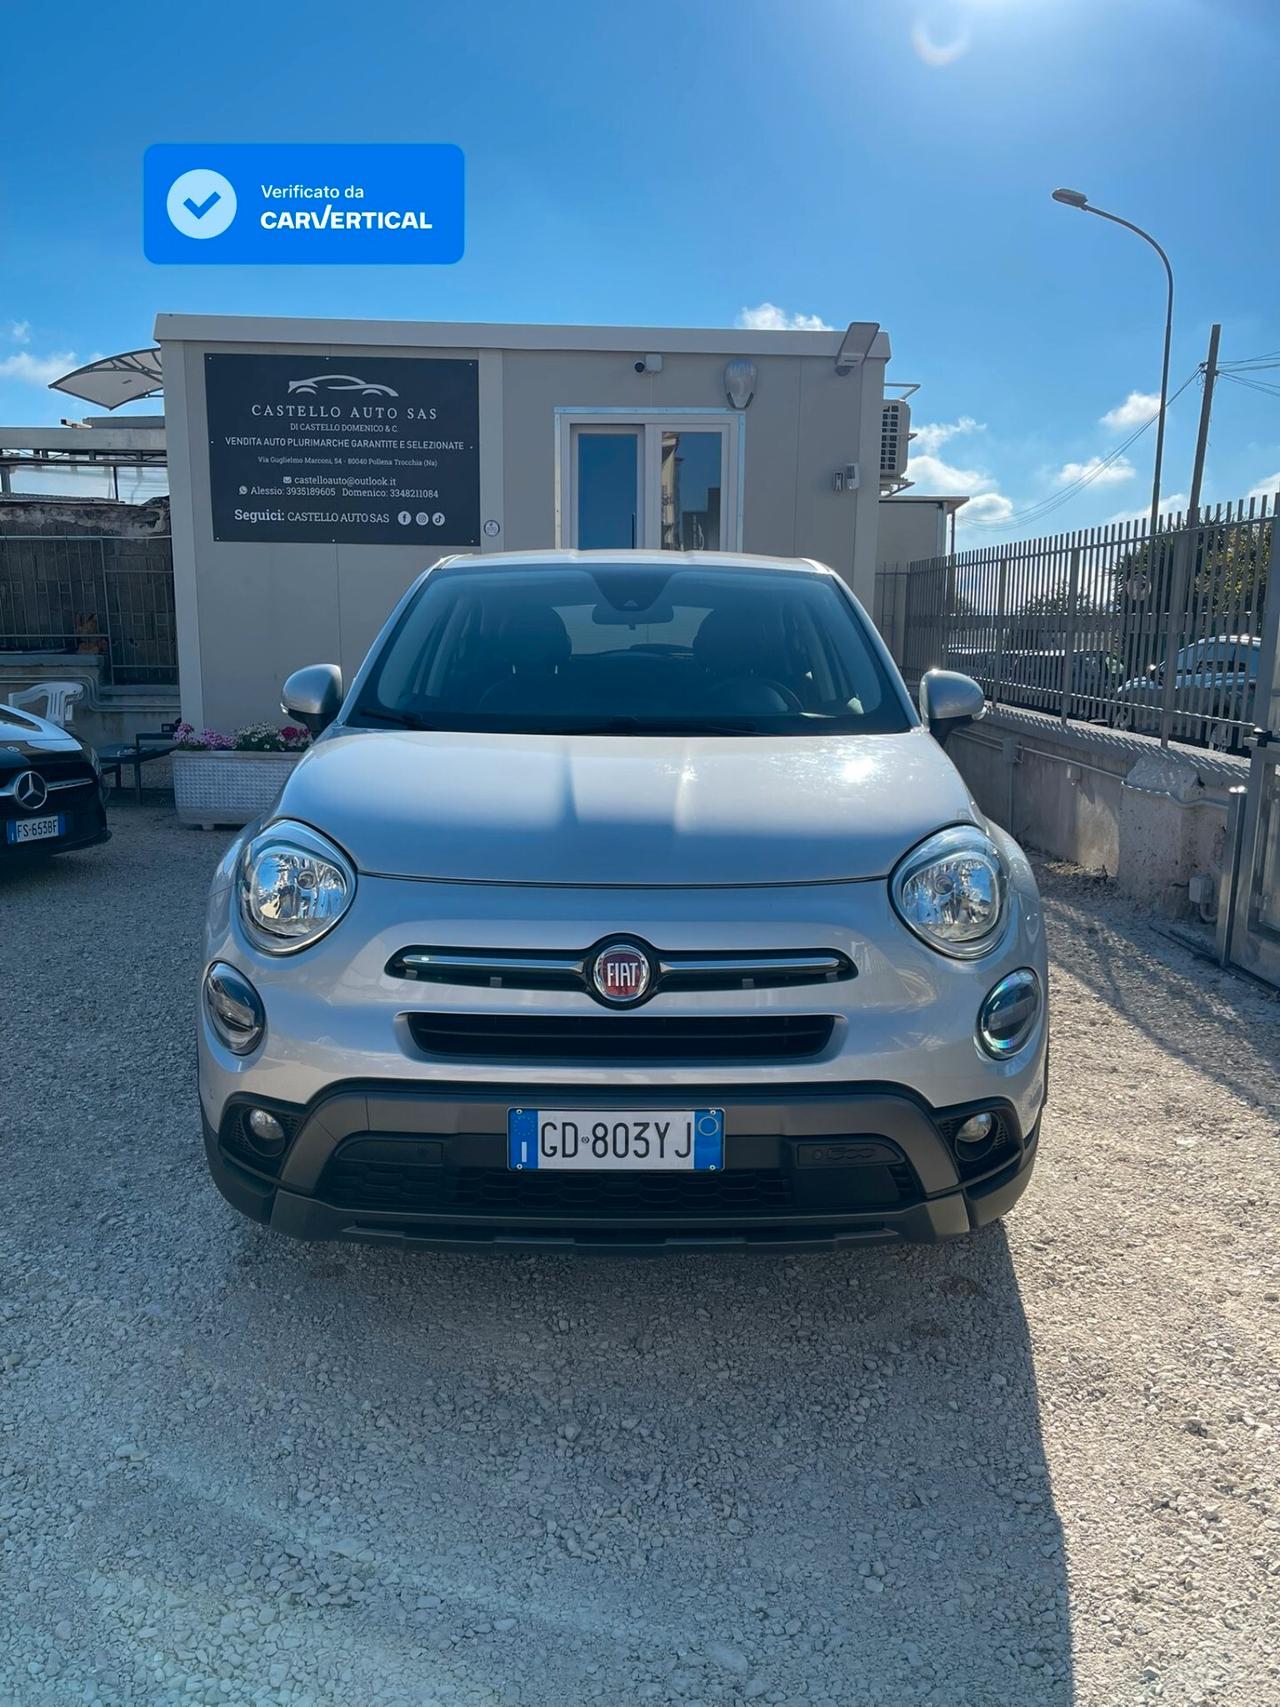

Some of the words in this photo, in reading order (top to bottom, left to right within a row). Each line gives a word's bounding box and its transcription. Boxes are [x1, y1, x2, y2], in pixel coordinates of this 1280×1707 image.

[251, 404, 341, 418] CASTELLO
[350, 406, 398, 419] AUTO
[407, 408, 437, 420] SAS
[290, 423, 299, 431] DI
[300, 423, 340, 432] CASTELLO
[341, 424, 384, 433] DOMENICO
[385, 425, 391, 433] &
[225, 437, 262, 446] VENDITA
[263, 438, 287, 447] AUTO
[287, 438, 350, 448] PLURIMARCHE
[351, 440, 399, 449] GARANTITE
[400, 441, 405, 449] E
[406, 441, 465, 450] SELEZIONATE
[294, 476, 396, 486] castelloauto@outlook.it
[250, 487, 284, 496] Alessio:
[286, 487, 336, 497] 3935189605
[342, 488, 388, 497] Domenico:
[390, 489, 439, 498] 3348211084
[234, 508, 285, 523] Seguici:
[287, 511, 339, 522] CASTELLO
[340, 513, 369, 523] AUTO
[369, 513, 390, 523] SAS
[607, 962, 638, 987] FIAT
